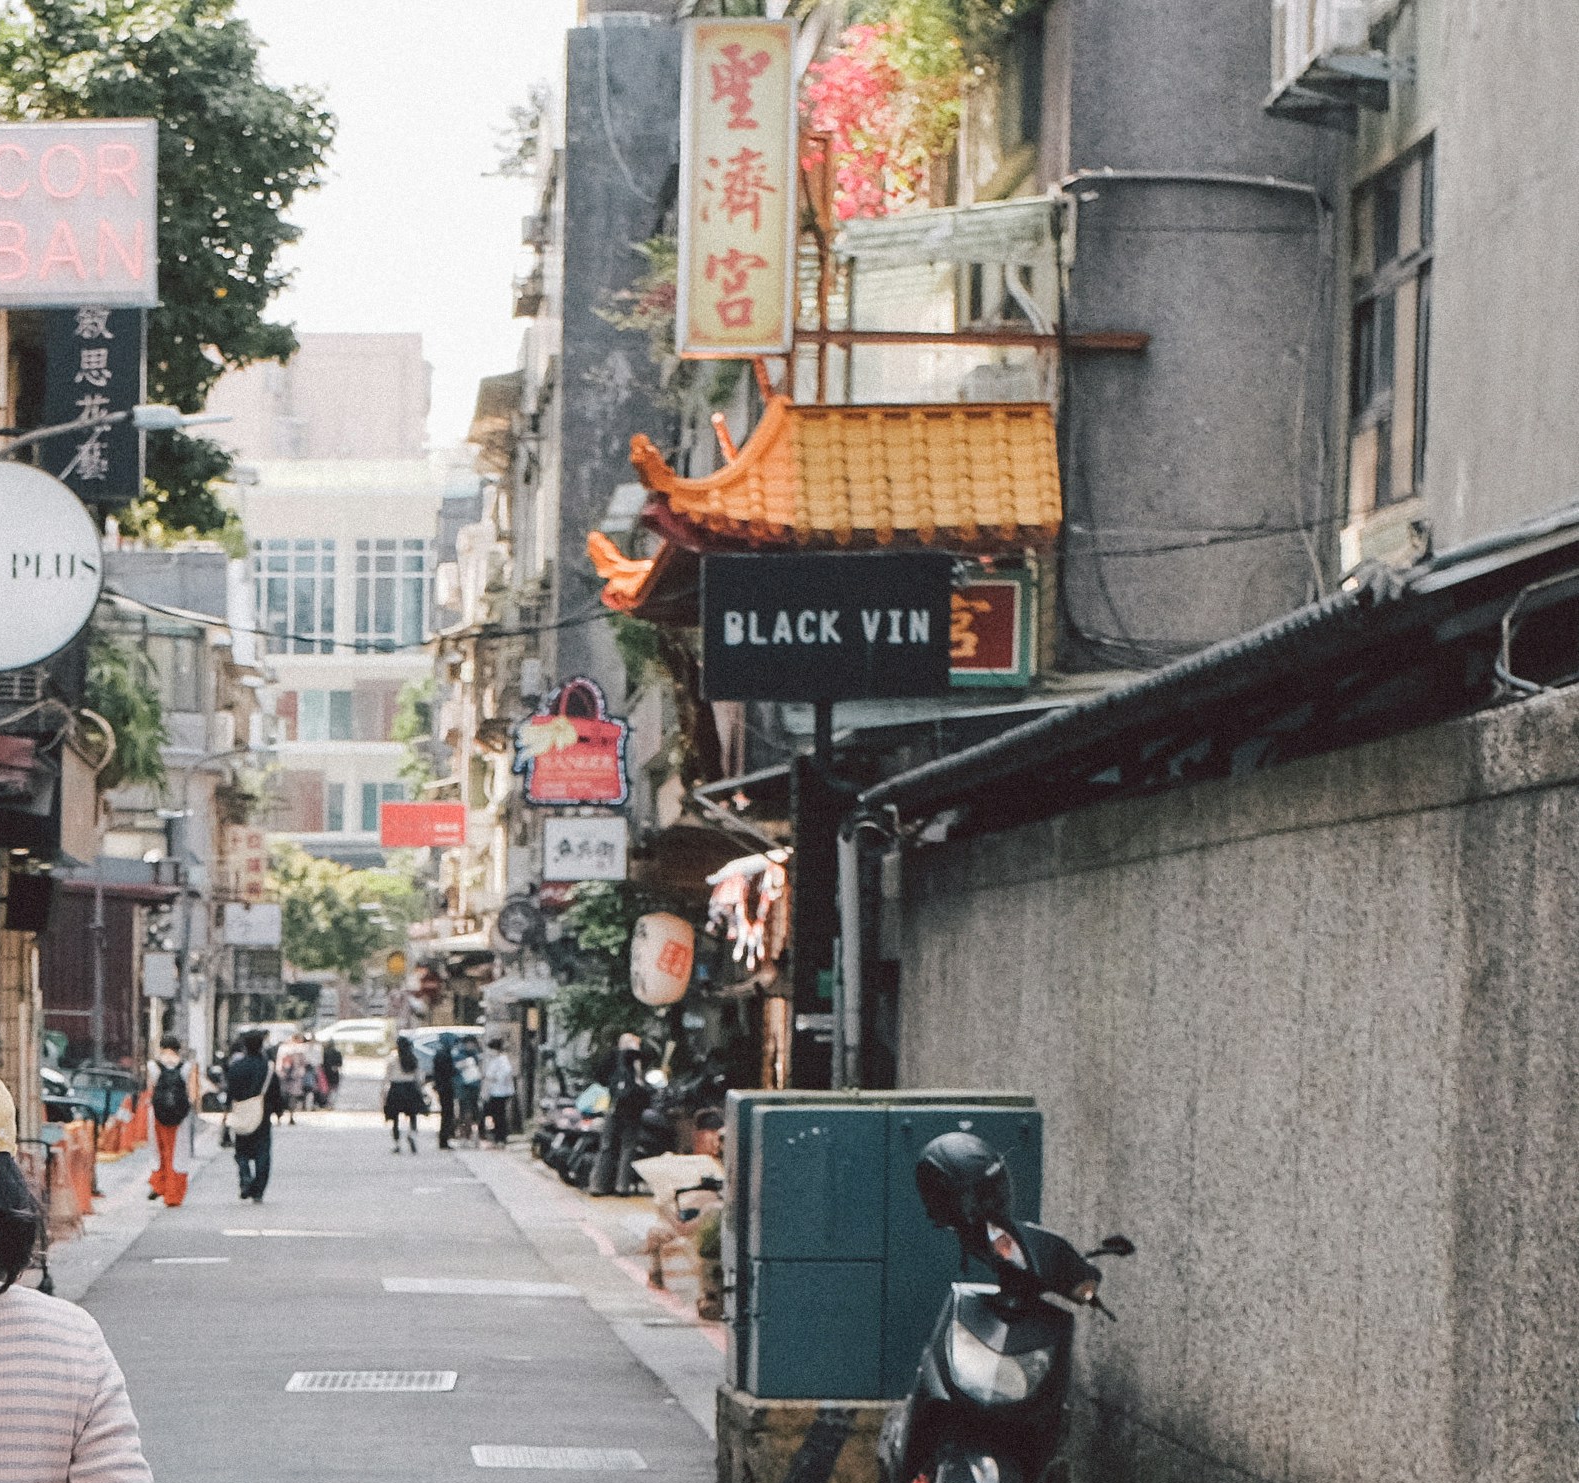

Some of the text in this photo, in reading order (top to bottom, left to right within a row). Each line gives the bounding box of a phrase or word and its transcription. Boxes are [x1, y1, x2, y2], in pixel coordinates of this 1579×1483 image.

[701, 42, 777, 329] 聖濟宮
[12, 552, 97, 579] PLUS
[724, 609, 930, 645] BLACK VIN
